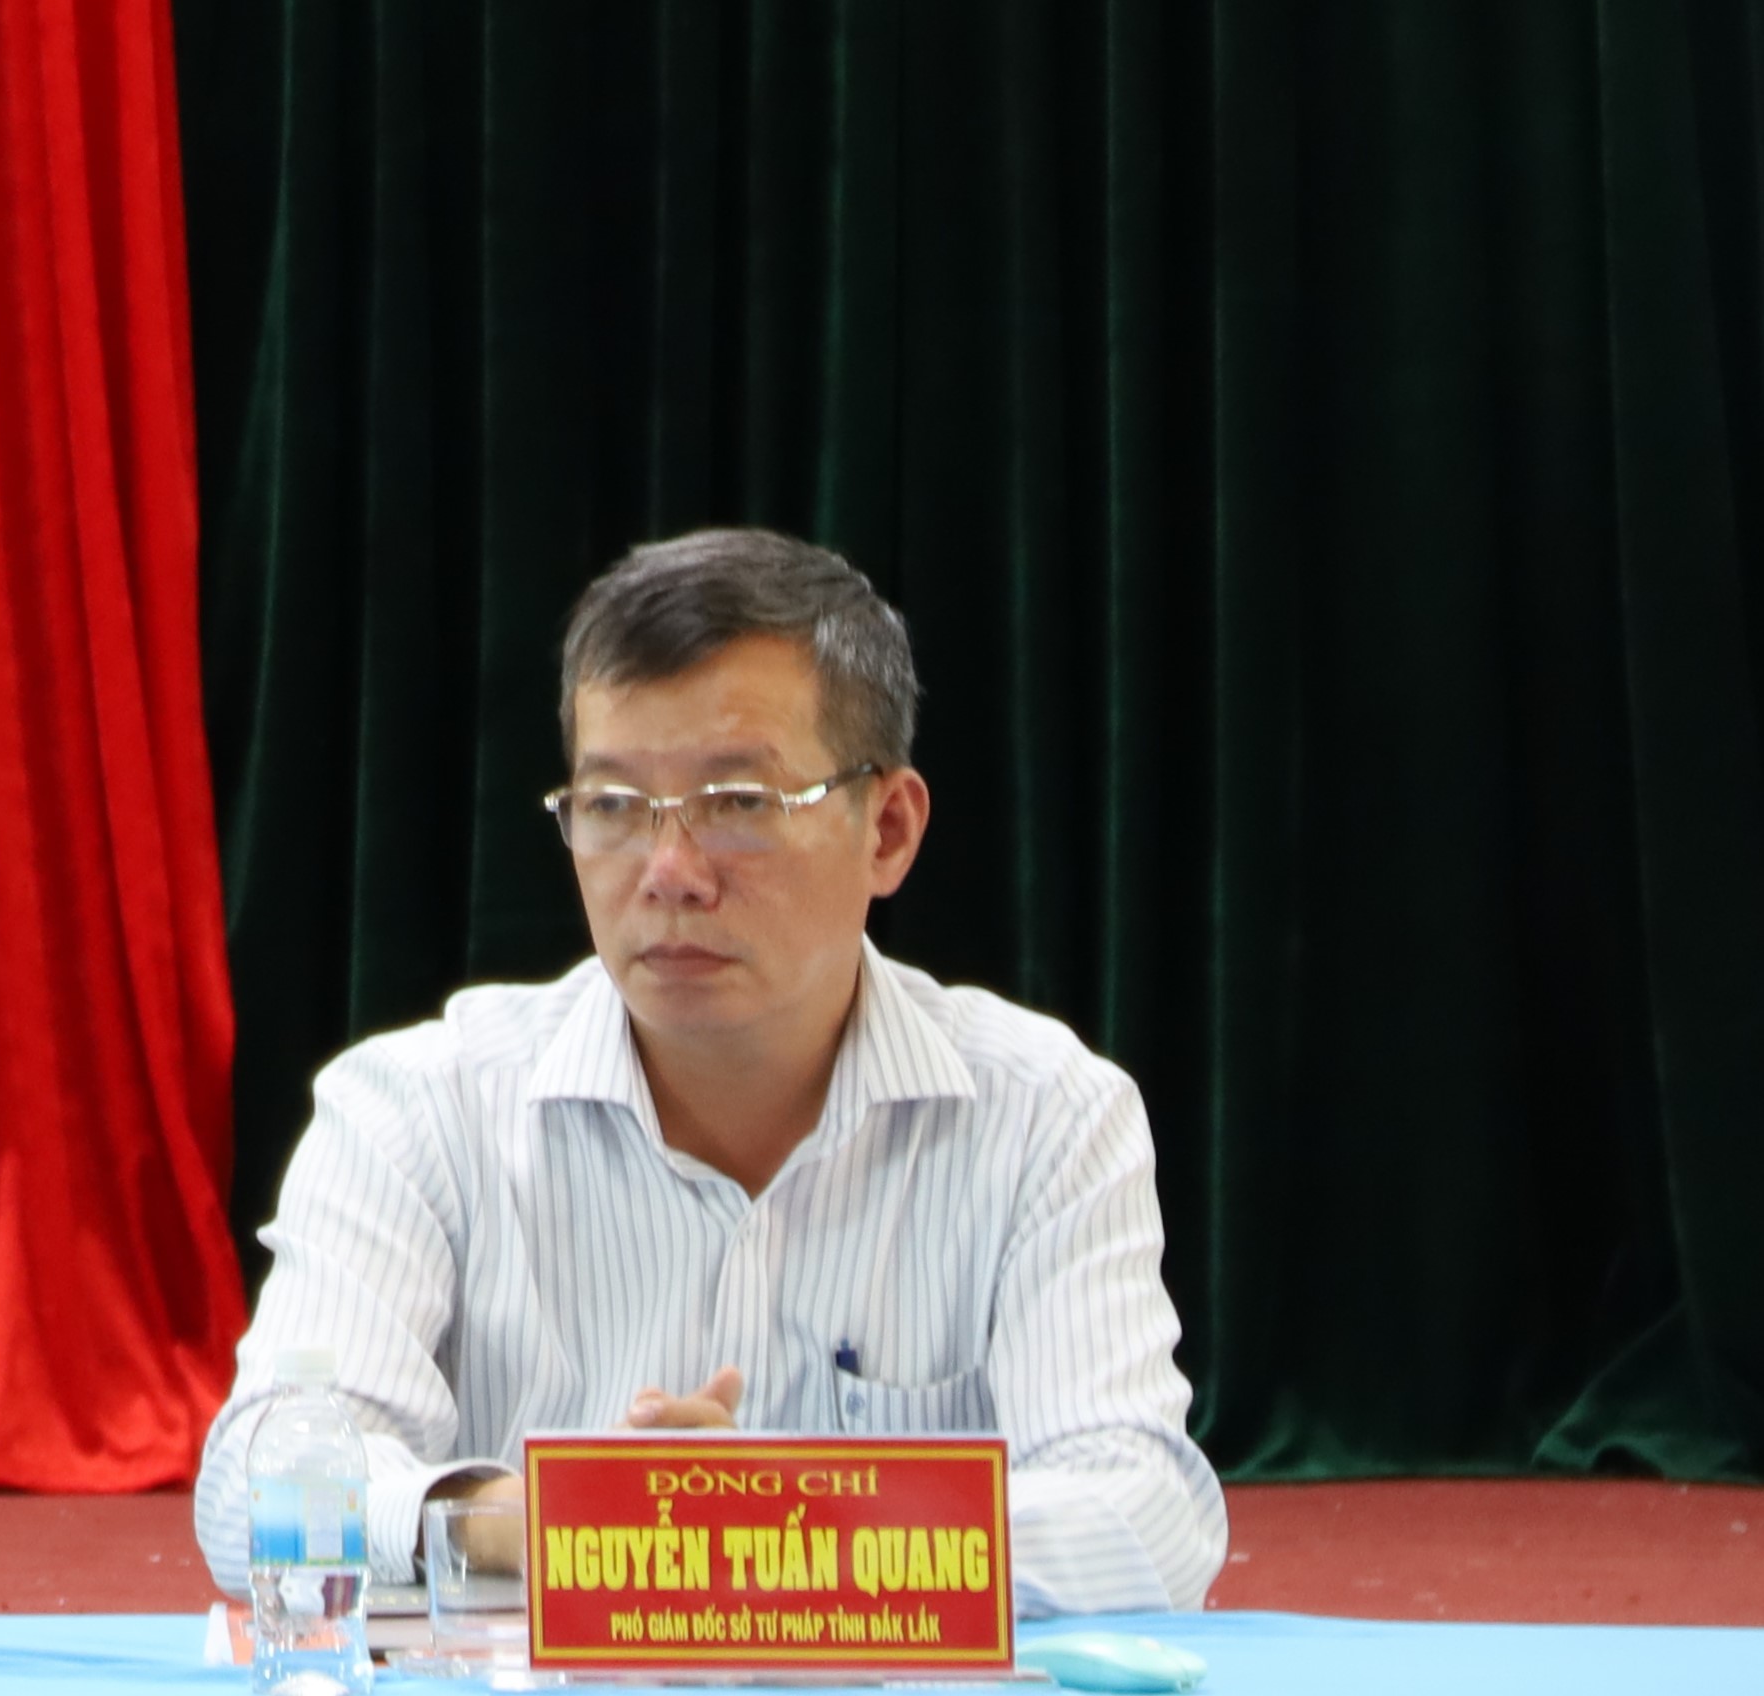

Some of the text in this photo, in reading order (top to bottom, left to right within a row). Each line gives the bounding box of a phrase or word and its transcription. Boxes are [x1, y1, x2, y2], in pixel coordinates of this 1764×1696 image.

[797, 1465, 878, 1496] CHÍ
[546, 1499, 990, 1598] NGUYỄN TUẤN QUANG
[611, 1606, 644, 1641] PHÓ
[648, 1606, 689, 1641] GIÁM
[782, 1607, 825, 1642] PHÁP
